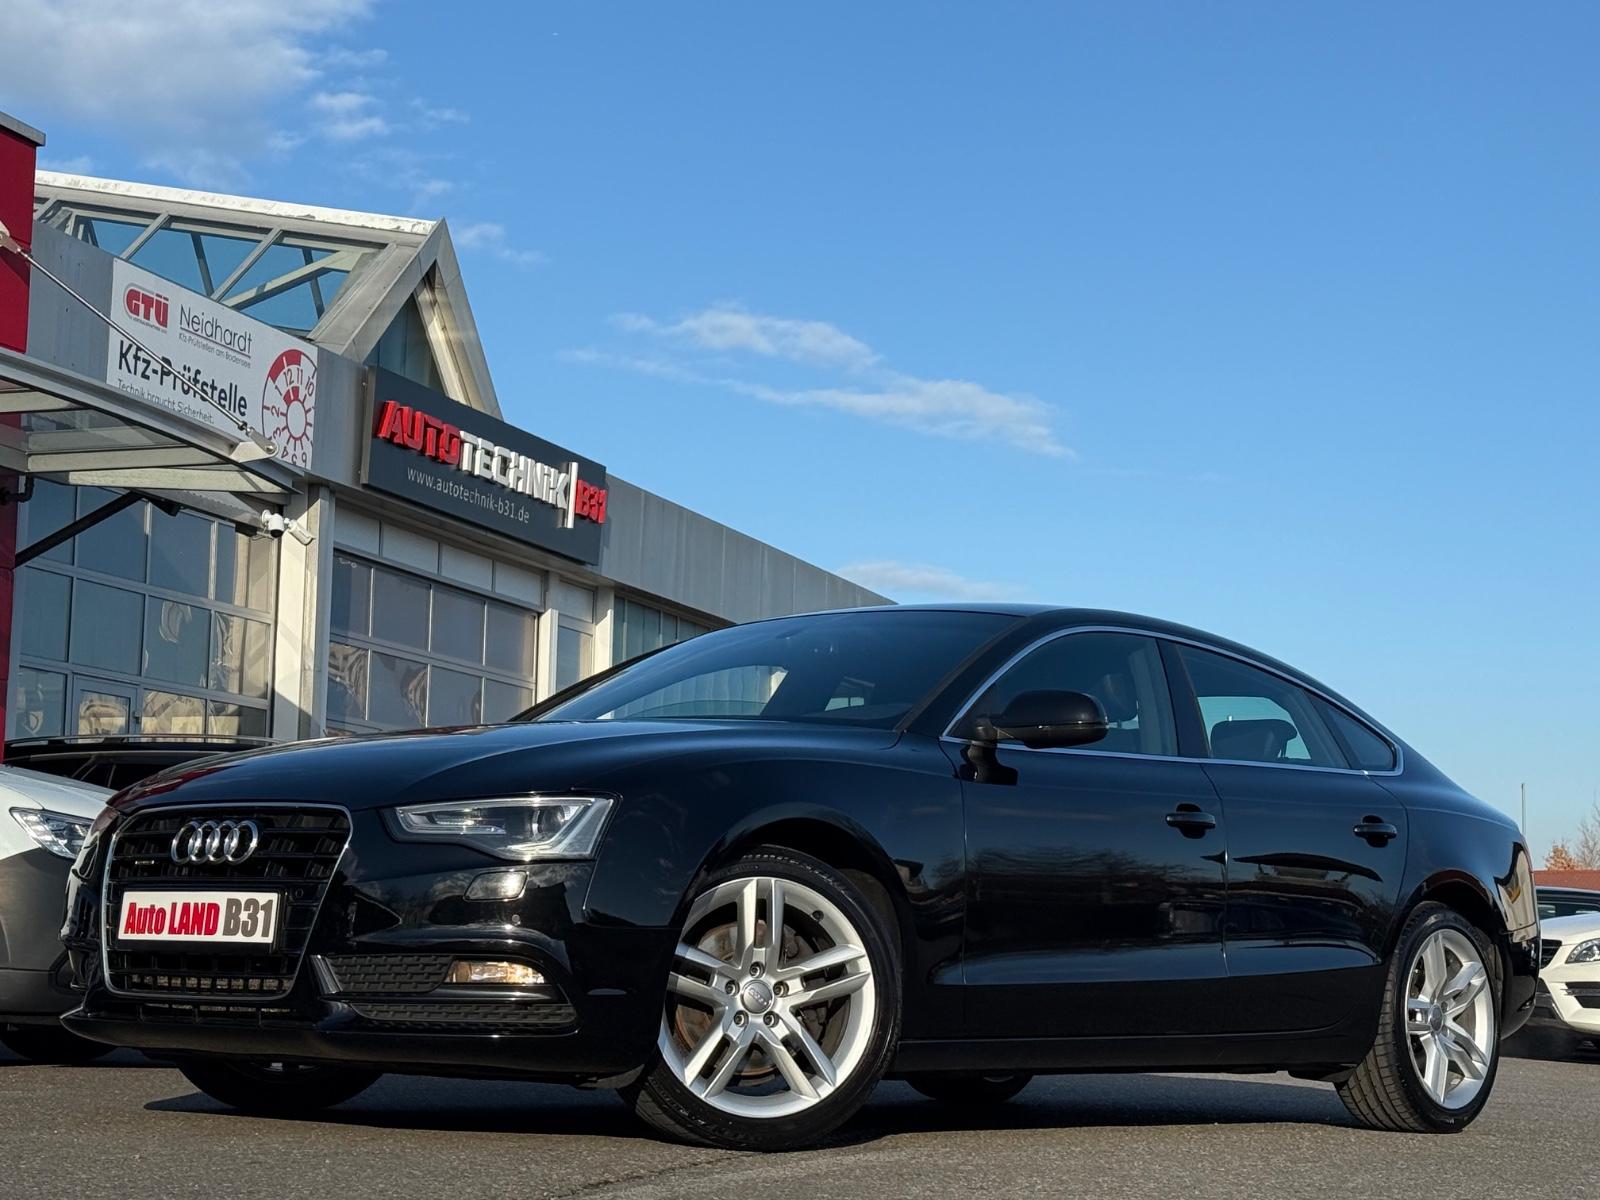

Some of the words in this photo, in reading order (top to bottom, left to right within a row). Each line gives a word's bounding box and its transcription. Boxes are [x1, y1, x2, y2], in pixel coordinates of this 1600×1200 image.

[125, 288, 170, 329] GTÜ
[180, 303, 253, 354] Neidhardt
[117, 378, 145, 400] Technik
[118, 339, 248, 417] Kfz-Prüfstelle
[406, 465, 530, 525] www.autotechnik-b31.de
[575, 479, 608, 524] B31
[123, 902, 167, 935] Auto
[167, 902, 220, 936] LAND
[222, 898, 274, 938] B31
